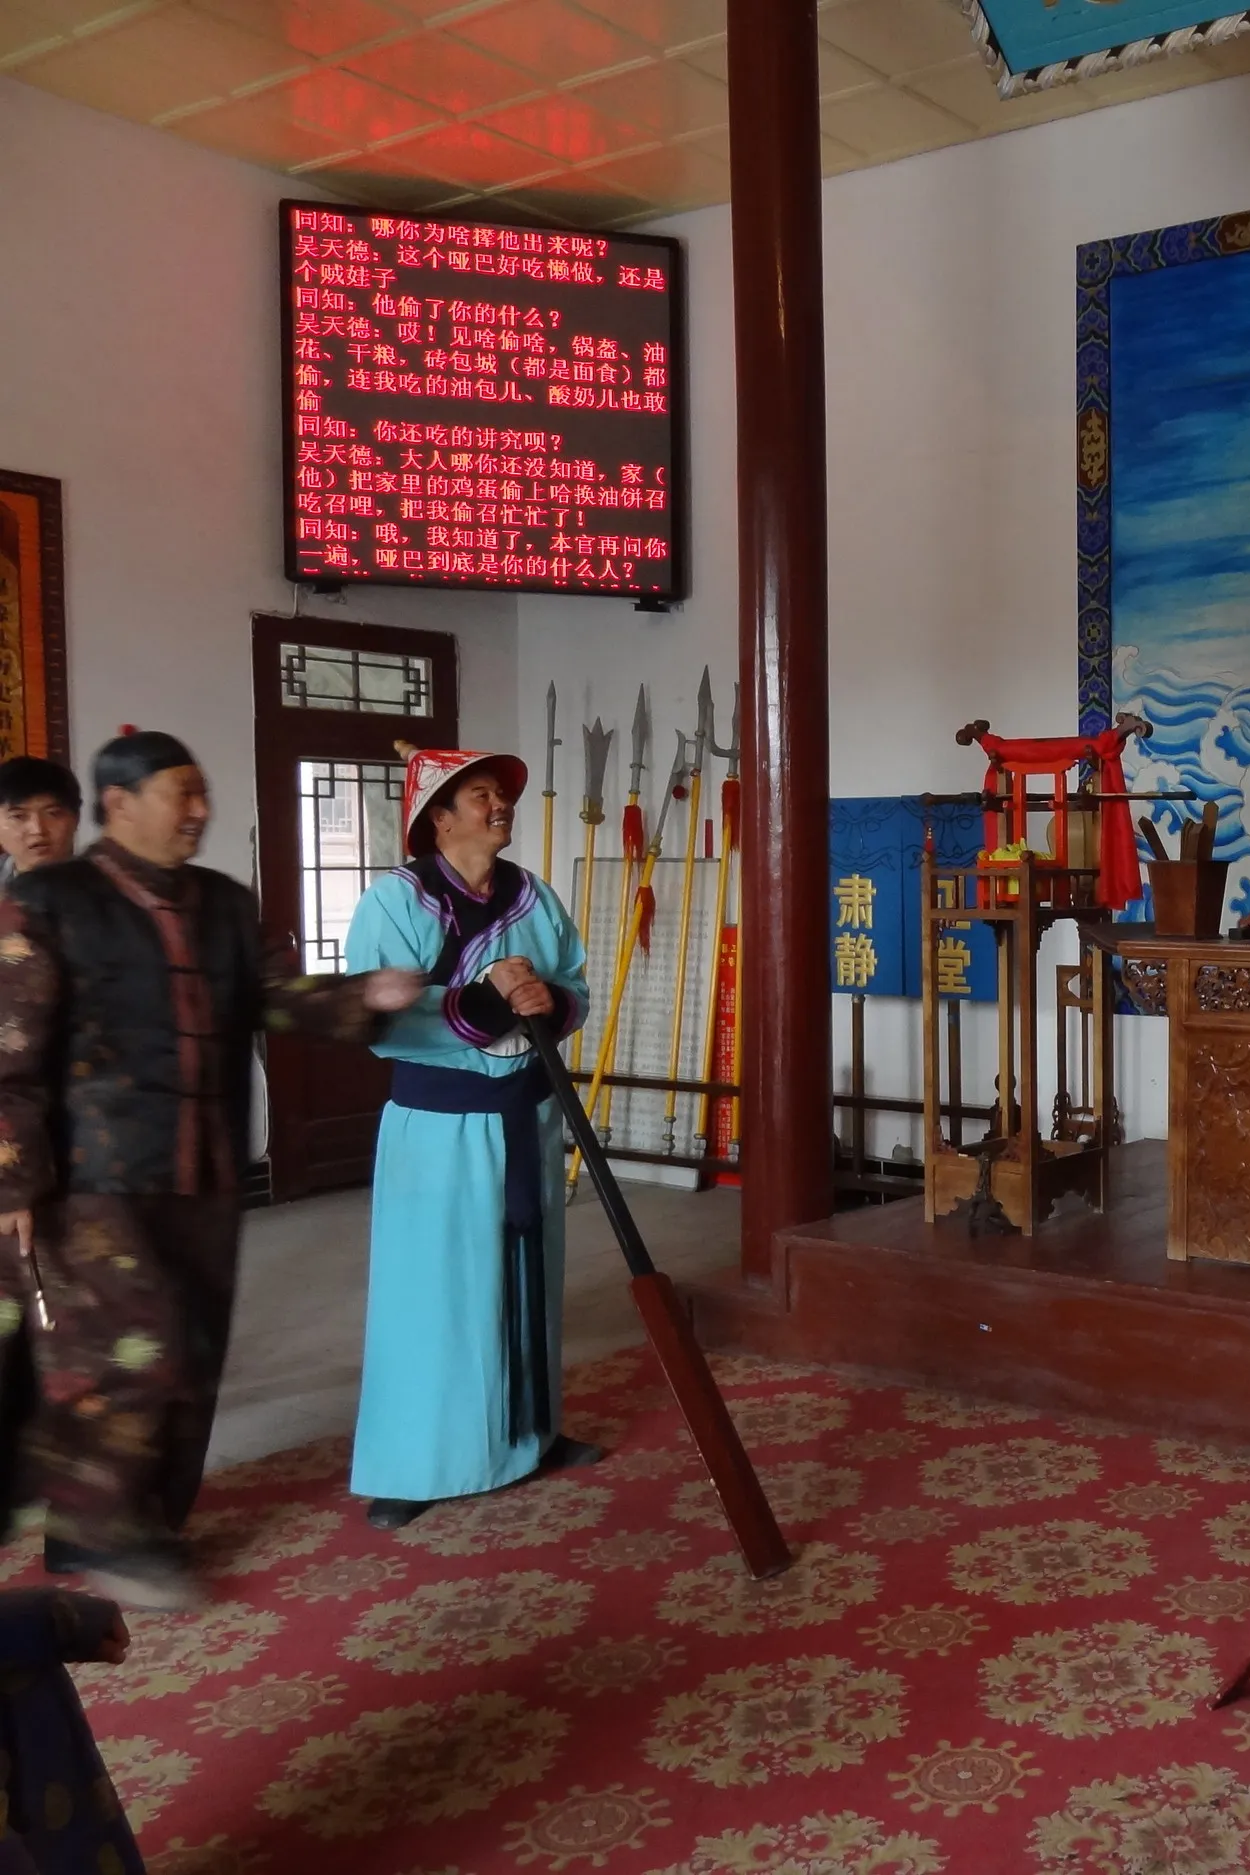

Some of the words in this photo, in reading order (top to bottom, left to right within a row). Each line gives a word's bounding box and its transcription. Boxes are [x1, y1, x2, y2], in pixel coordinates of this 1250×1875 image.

[295, 260, 396, 289] 个贼娃子
[296, 287, 562, 328] 同知：他偷了你的什么？
[297, 389, 321, 411] 偷
[834, 873, 877, 987] 肃静
